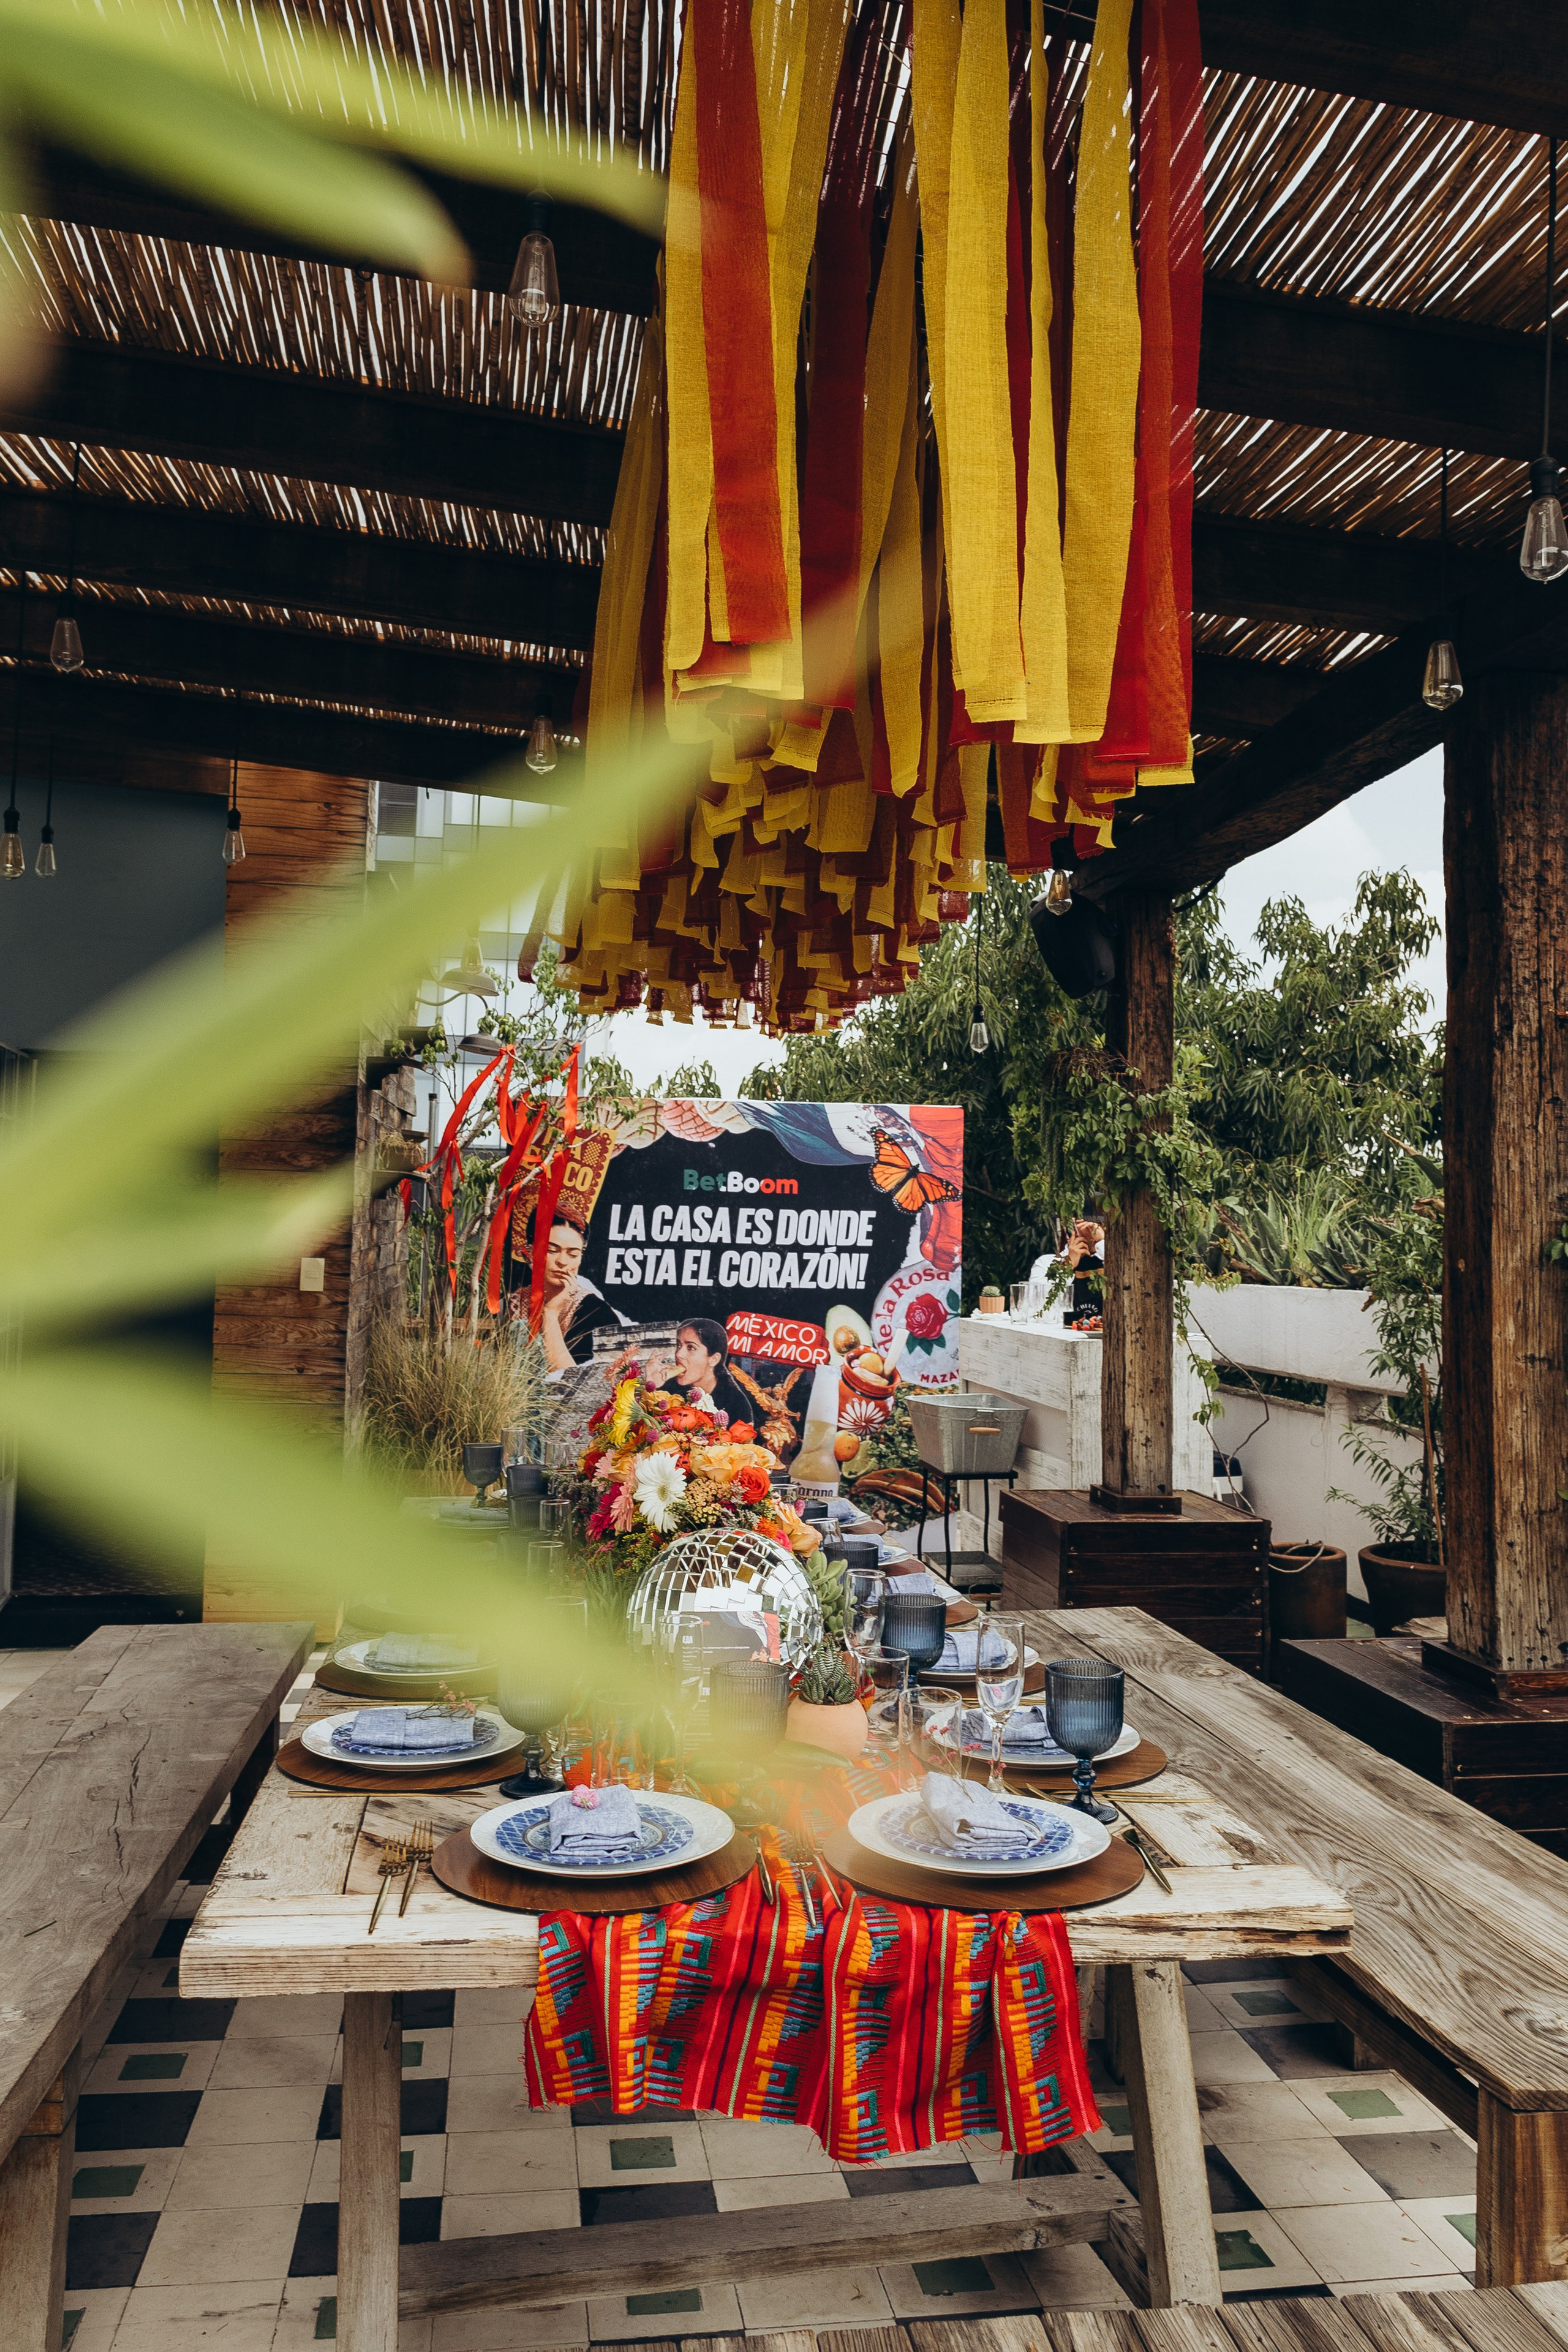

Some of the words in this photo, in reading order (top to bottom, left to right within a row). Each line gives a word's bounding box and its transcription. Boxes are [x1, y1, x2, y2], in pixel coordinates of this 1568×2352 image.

[683, 1169, 798, 1194] BetBoom
[608, 1204, 646, 1241] LA
[651, 1205, 731, 1243] CASA
[736, 1208, 774, 1245] ES
[775, 1209, 876, 1247] DONDE
[605, 1248, 677, 1285] ESTA
[681, 1249, 714, 1286] EL
[718, 1246, 869, 1289] CORAZÓN!
[889, 1268, 950, 1298] Rosa
[876, 1299, 897, 1322] la
[726, 1313, 816, 1344] MÉXICO
[877, 1324, 893, 1352] de
[728, 1335, 752, 1353] MI
[756, 1341, 827, 1365] AMOR
[920, 1369, 960, 1384] MAZA
